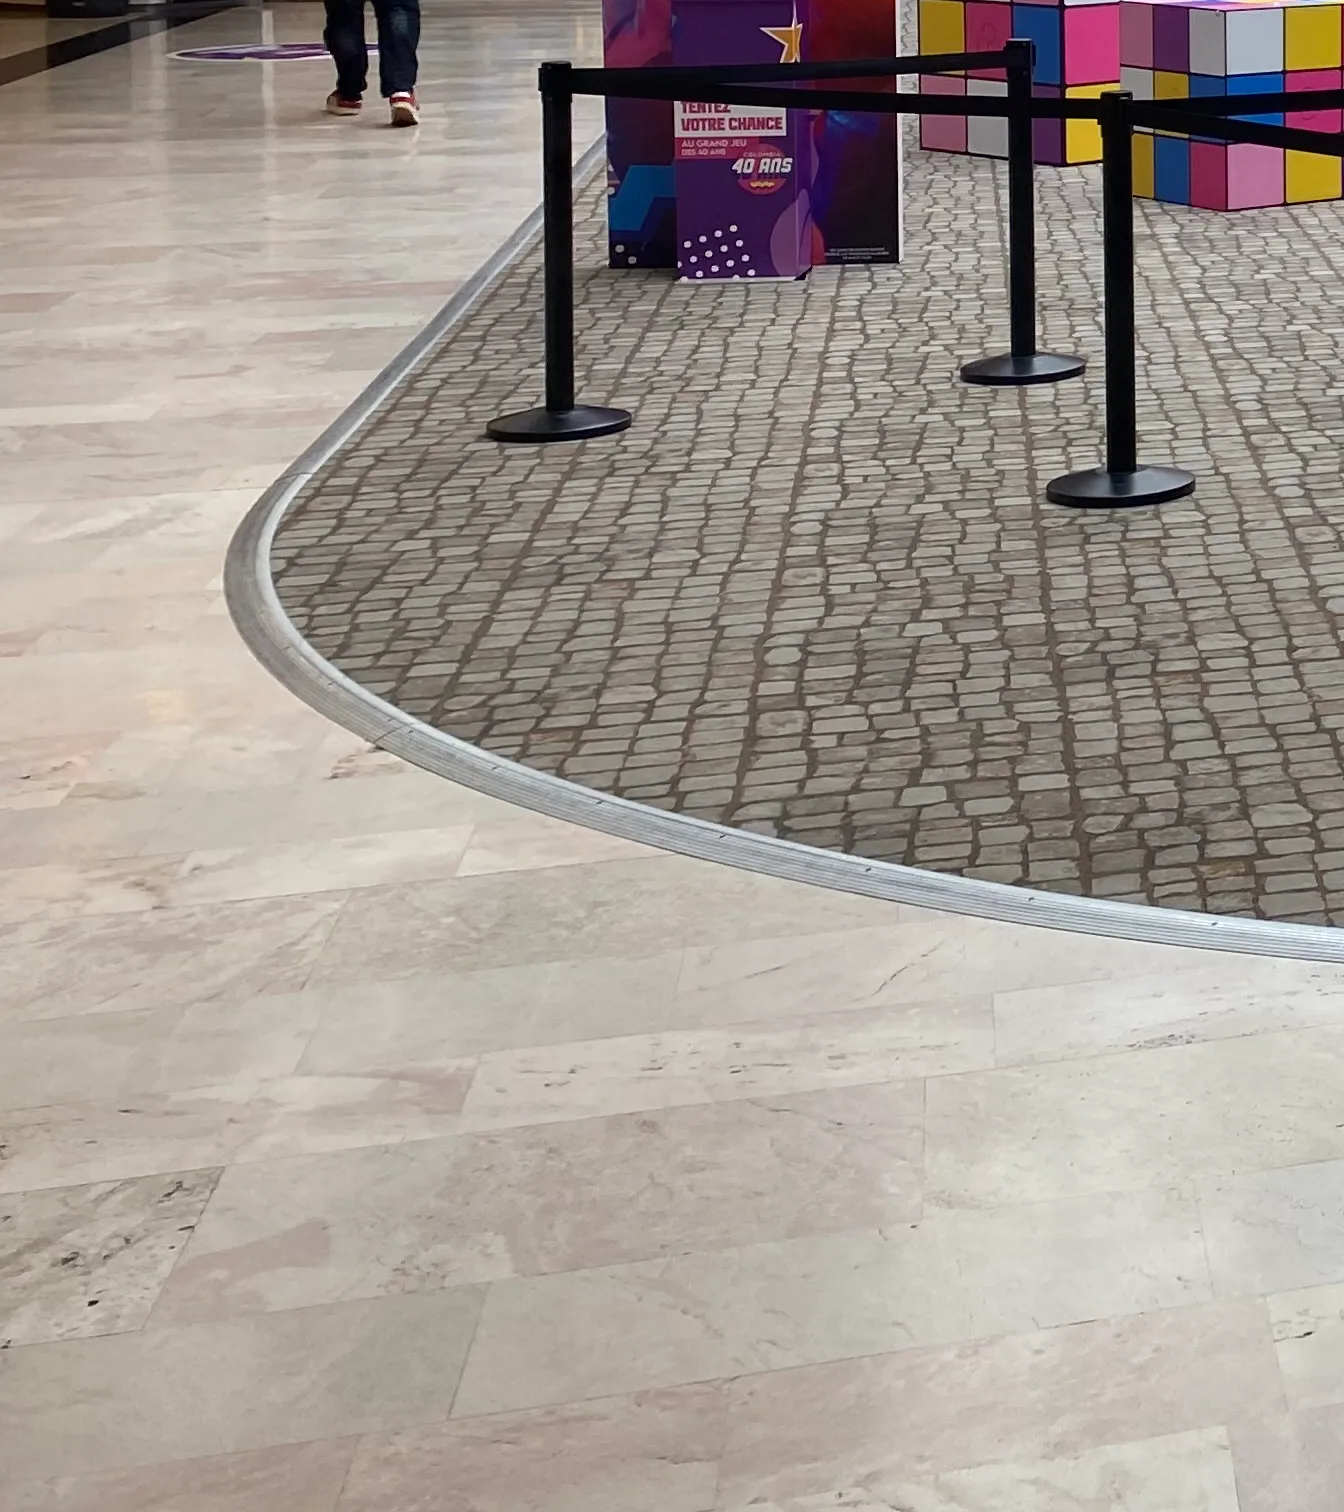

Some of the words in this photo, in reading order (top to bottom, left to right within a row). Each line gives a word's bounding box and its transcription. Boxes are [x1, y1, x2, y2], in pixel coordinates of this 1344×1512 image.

[681, 117, 726, 132] VOTRE
[728, 116, 783, 131] CHANCE
[681, 139, 695, 148] AU
[696, 139, 729, 148] GRAND
[730, 139, 747, 148] JEU
[731, 157, 756, 174] 40
[757, 157, 794, 174] ANS
